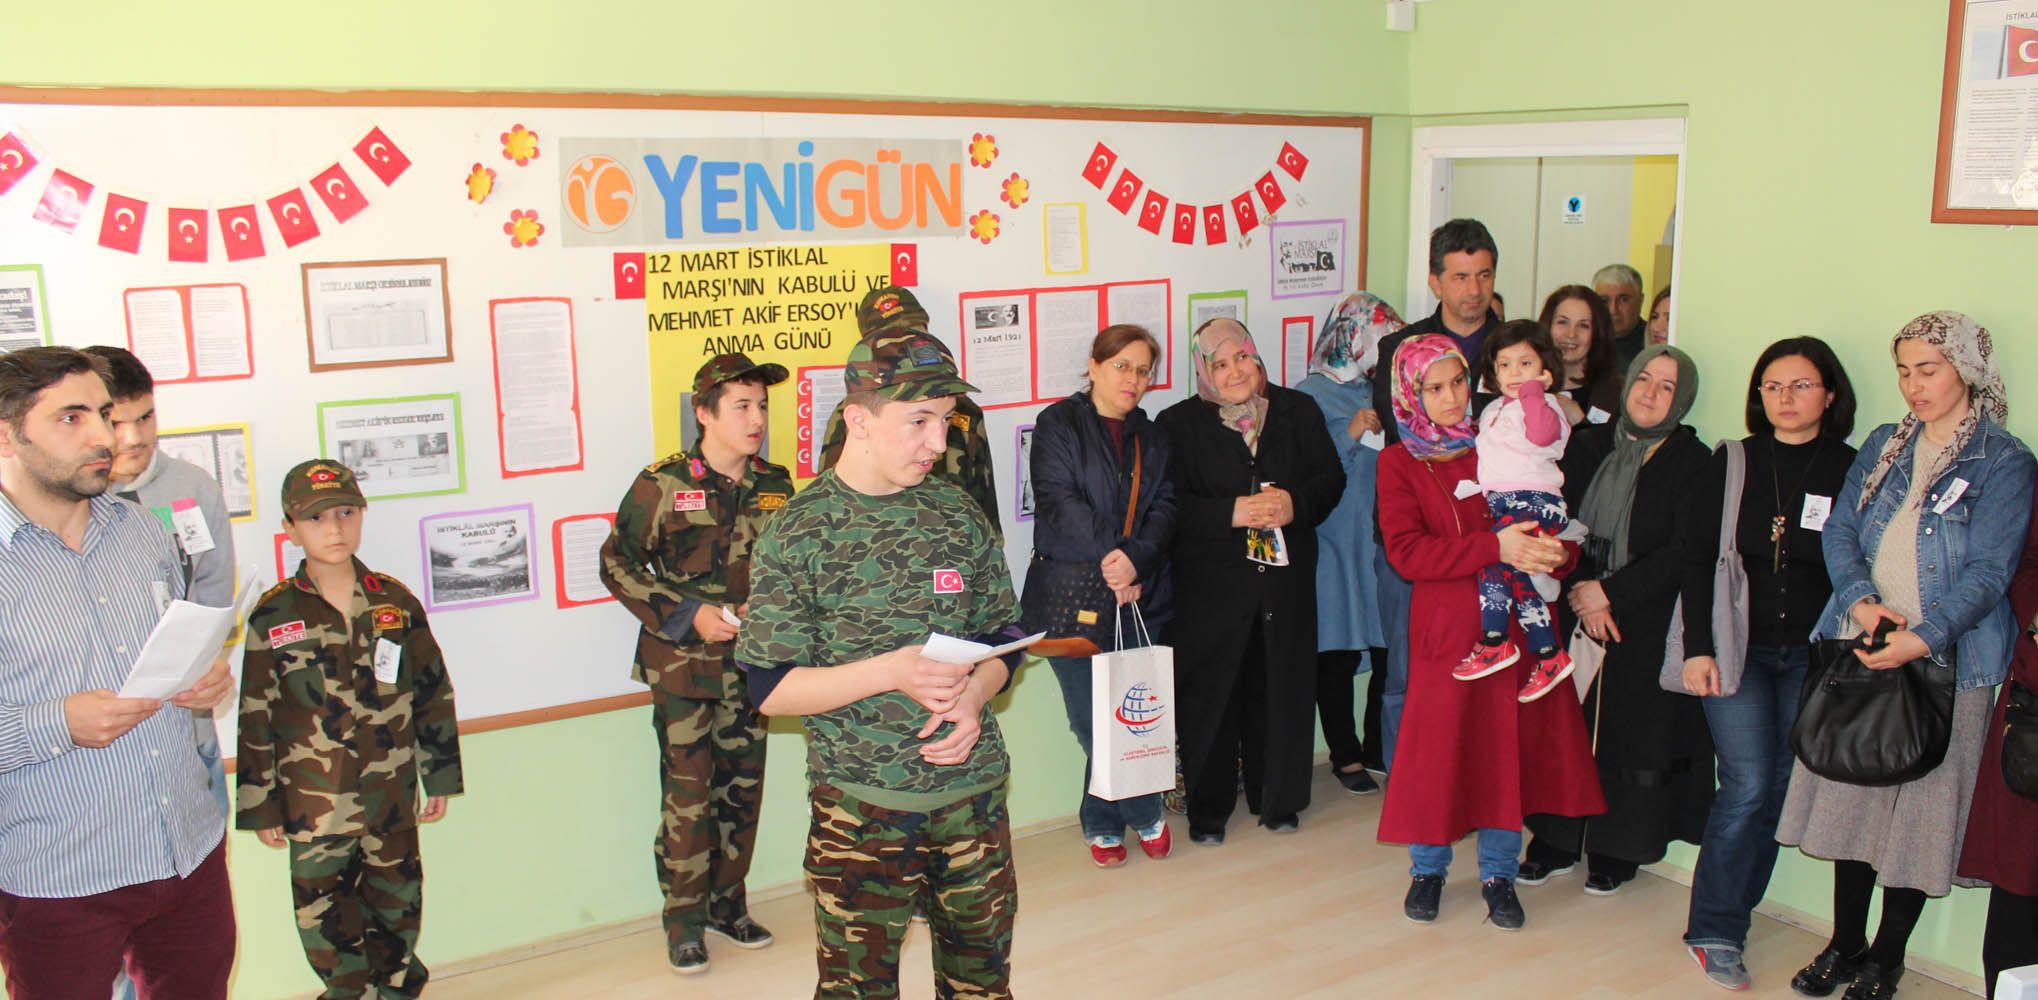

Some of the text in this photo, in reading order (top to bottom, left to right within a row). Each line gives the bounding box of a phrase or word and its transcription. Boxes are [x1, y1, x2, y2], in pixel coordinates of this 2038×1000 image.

[643, 141, 962, 239] YENİGÜN
[648, 246, 828, 274] 12 MART İSTİKLAL
[663, 270, 889, 302] MARŞI'NIN KABULÜ VE
[648, 307, 732, 333] MEHMET
[741, 300, 782, 325] AKİF
[702, 325, 832, 356] ANMA GÜNÜ
